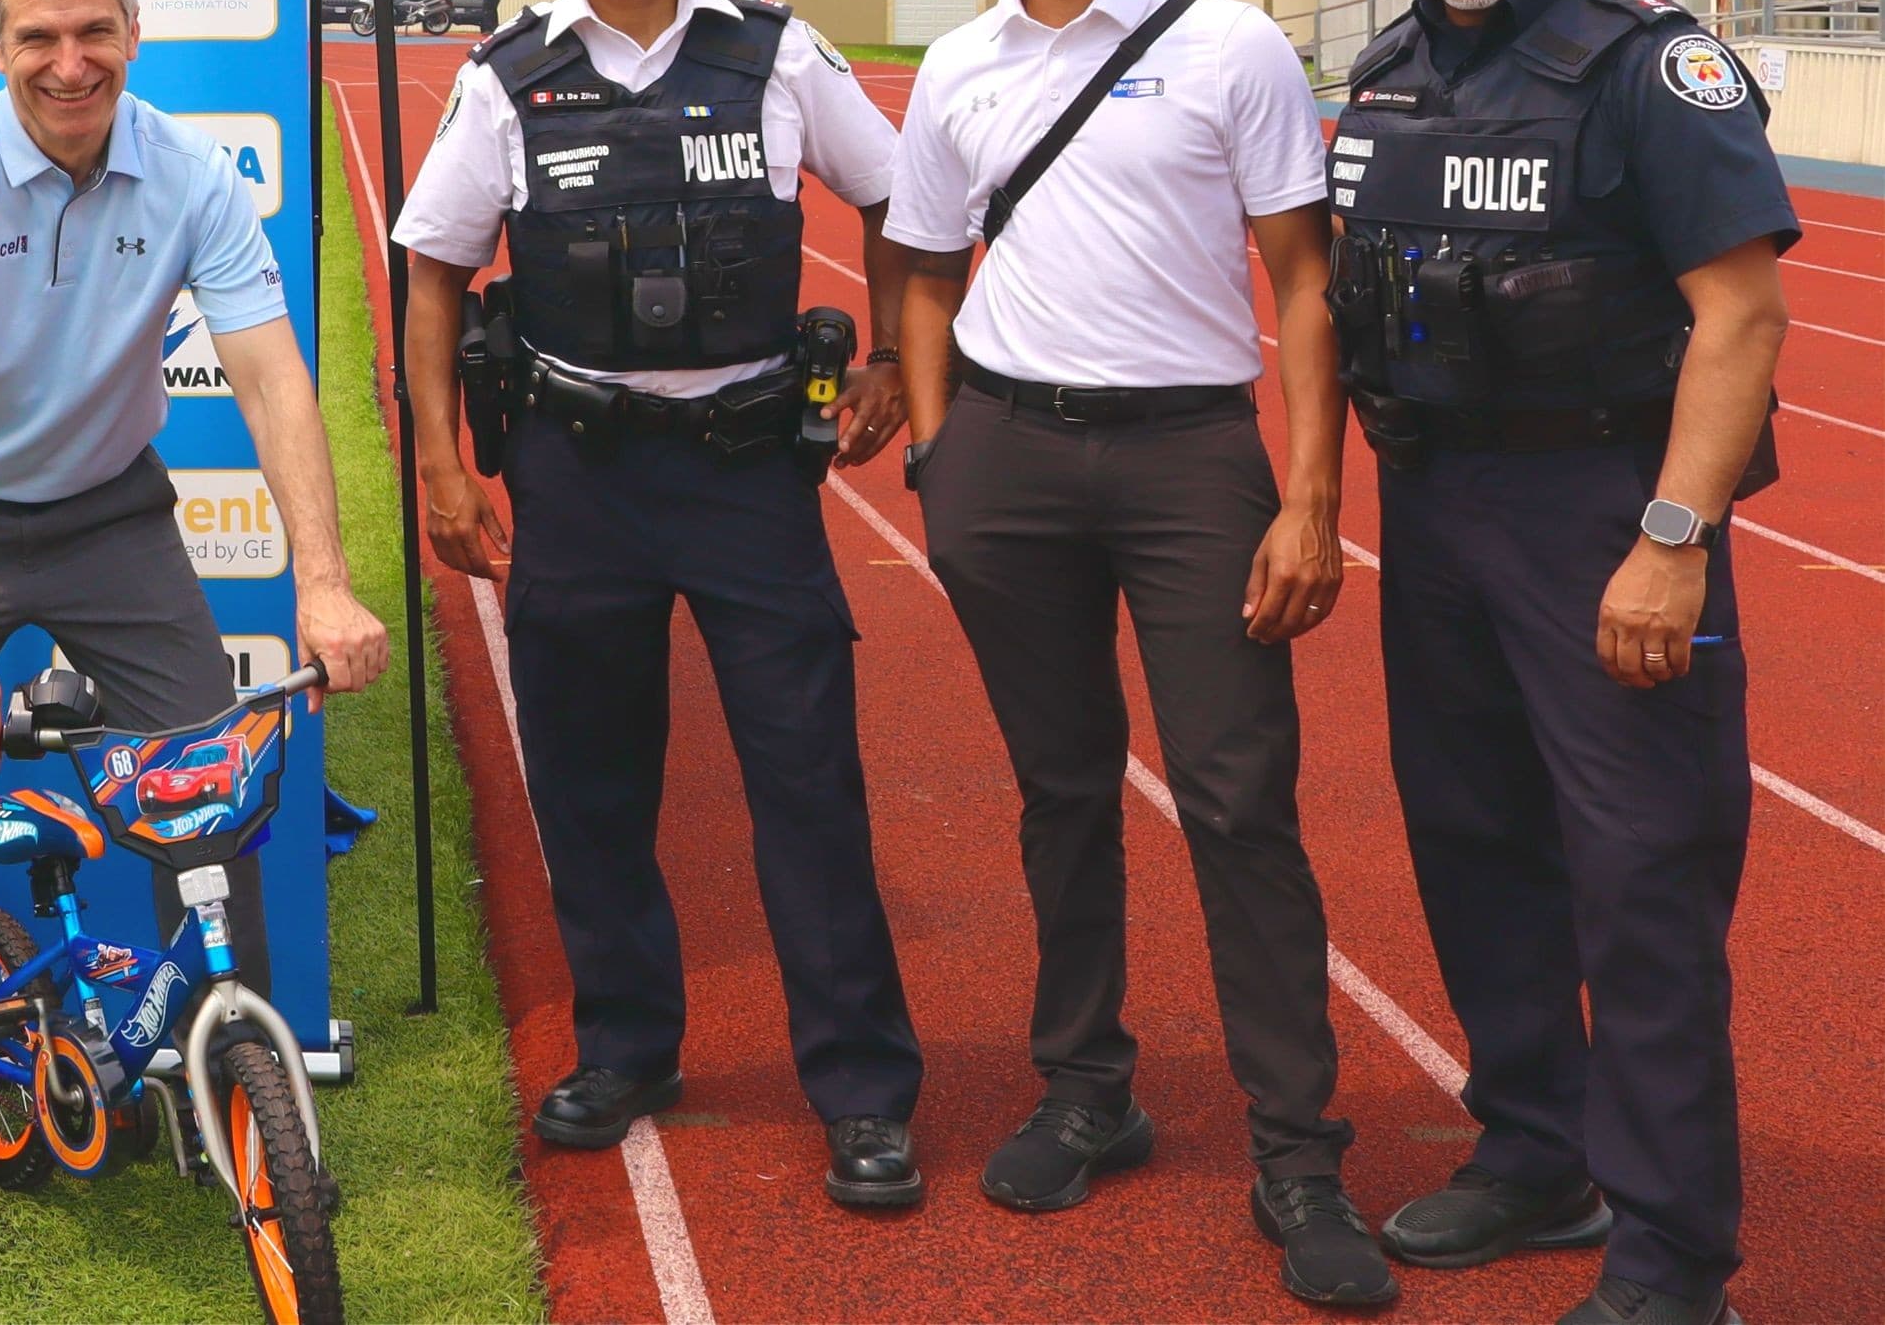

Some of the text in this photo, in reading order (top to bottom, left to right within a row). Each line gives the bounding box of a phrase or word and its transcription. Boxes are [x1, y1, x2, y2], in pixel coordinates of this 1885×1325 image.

[151, 0, 249, 11] INFORMATION
[1669, 39, 1721, 59] TORONTO
[1696, 87, 1739, 104] POLICE
[536, 145, 610, 166] NEIGHBOURHOOD
[681, 133, 765, 182] POLICE
[548, 159, 600, 177] COMMUNITY
[559, 174, 595, 190] OFFICER
[1443, 155, 1549, 212] POLICE
[261, 269, 282, 286] Tac
[185, 539, 273, 564] ed by GE
[112, 750, 134, 777] 68
